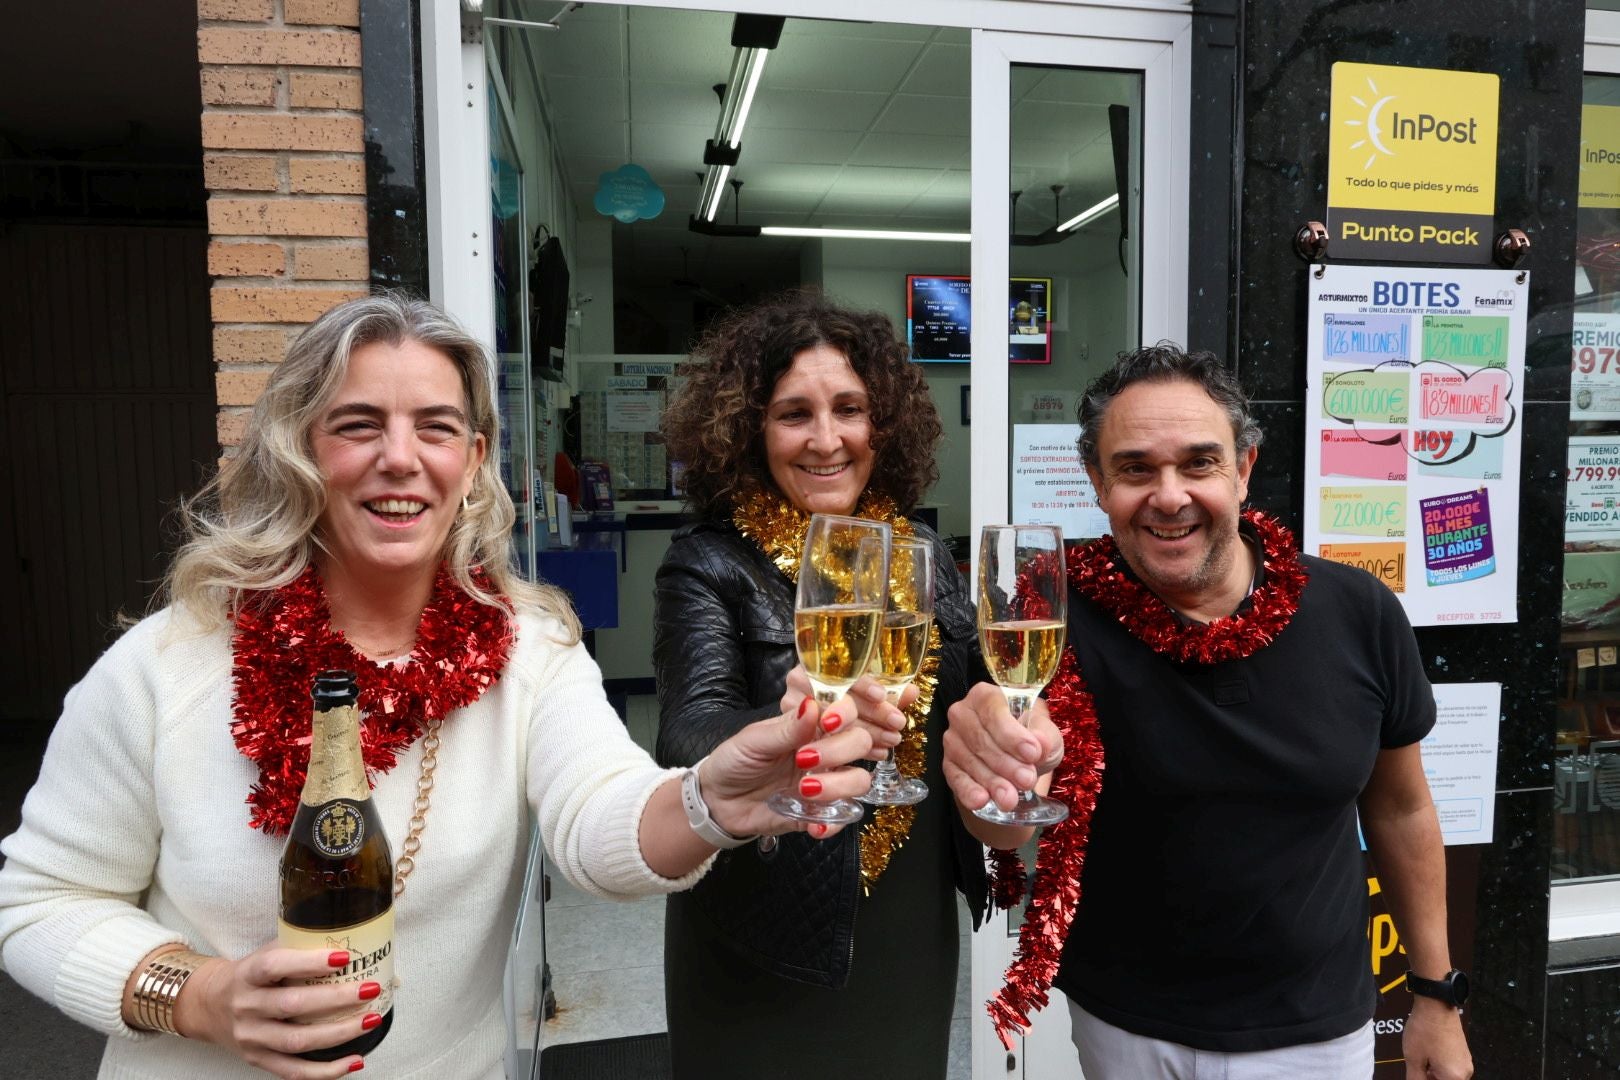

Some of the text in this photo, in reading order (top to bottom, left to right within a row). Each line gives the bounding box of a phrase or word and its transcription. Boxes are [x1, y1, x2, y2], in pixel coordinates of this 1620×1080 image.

[1392, 112, 1477, 144] InPost
[1346, 176, 1479, 194] Todo lo que pides y más
[1342, 222, 1479, 246] Punto Pack
[1318, 293, 1368, 303] ASTURMIXTOS
[1373, 281, 1460, 308] BOTES
[1474, 296, 1513, 306] Fenamix
[1389, 415, 1408, 424] Euros
[1413, 430, 1454, 460] HOY
[1579, 458, 1620, 466] MILLONAR
[1387, 472, 1406, 481] Euros
[1484, 471, 1502, 480] Euros
[1425, 502, 1481, 523] 20.000€
[1386, 528, 1405, 537] Euros
[1426, 515, 1473, 535] AL MES
[1426, 523, 1489, 547] DURANTE
[1428, 546, 1445, 560] 30
[1447, 538, 1483, 557] AÑOS
[1436, 613, 1475, 622] RECEPTOR
[345, 966, 379, 983] EXTRA
